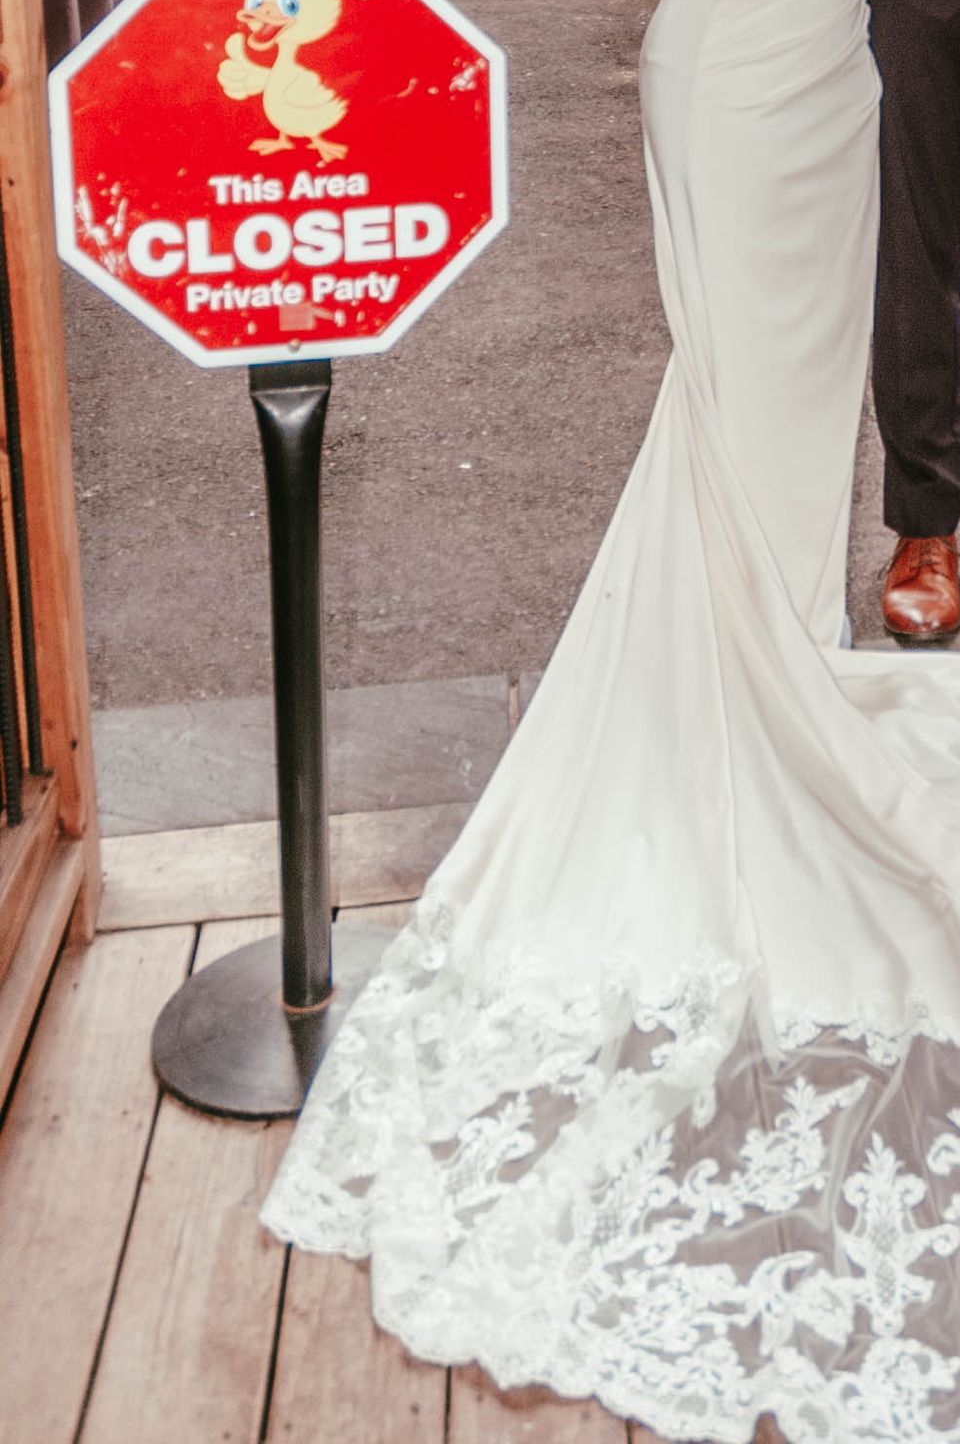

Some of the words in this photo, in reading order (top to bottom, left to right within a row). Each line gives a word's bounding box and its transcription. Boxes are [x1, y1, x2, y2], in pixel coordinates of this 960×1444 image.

[208, 174, 283, 206] This
[288, 169, 368, 200] Area
[127, 204, 451, 278] CLOSED
[186, 280, 304, 313] Private
[312, 273, 401, 304] Party
